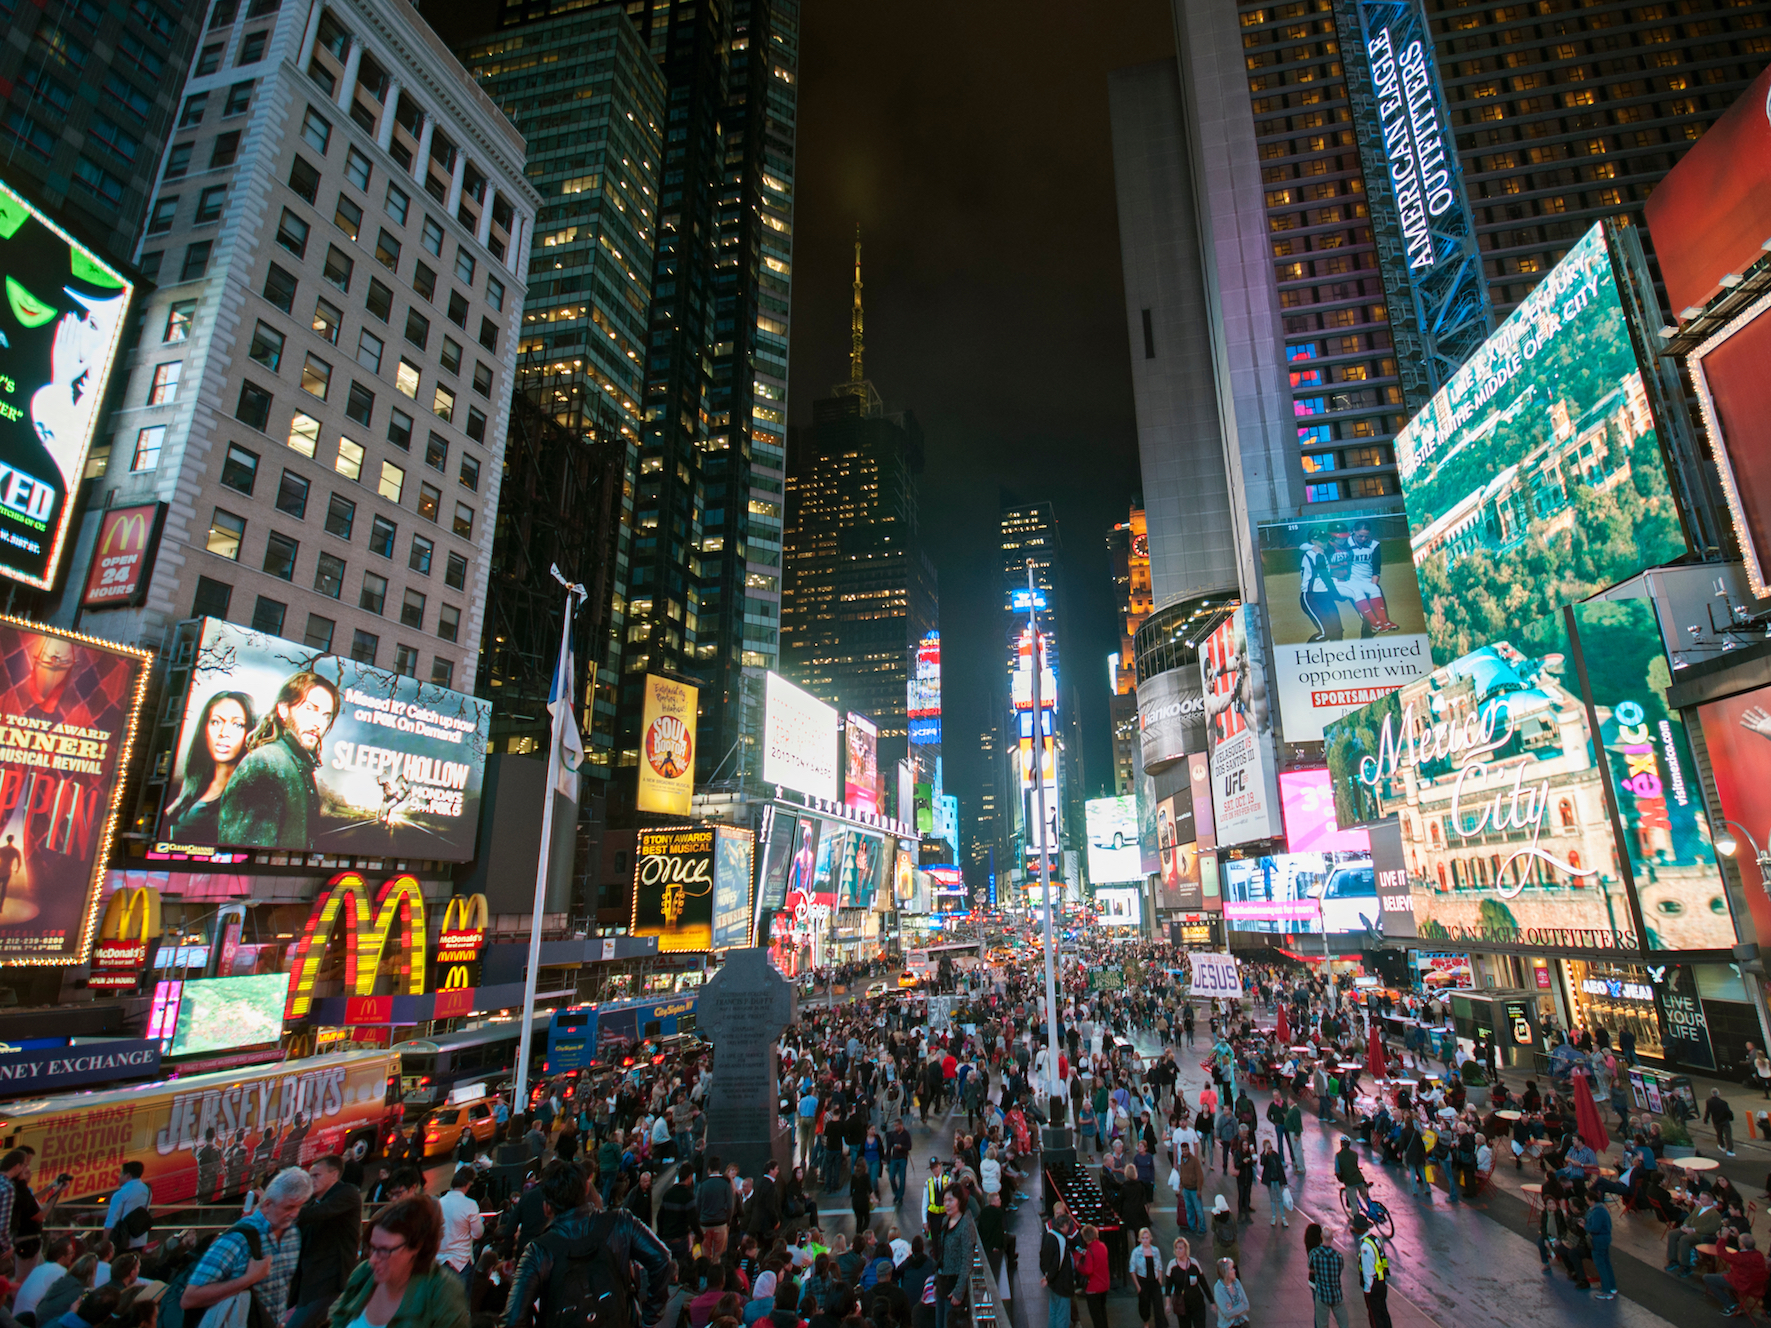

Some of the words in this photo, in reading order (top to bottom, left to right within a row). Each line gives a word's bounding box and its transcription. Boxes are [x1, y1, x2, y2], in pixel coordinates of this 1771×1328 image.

[1368, 27, 1402, 121] EAGLE
[1399, 40, 1453, 216] OUTFITTERS
[1383, 115, 1434, 270] AMERICAN
[1519, 250, 1585, 330] CENTURY
[1436, 426, 1451, 446] IN
[1446, 401, 1473, 434] THE
[1473, 353, 1523, 411] MIDDLE
[1523, 331, 1546, 360] OF
[1548, 319, 1563, 340] A
[1563, 274, 1599, 321] CITY
[101, 554, 138, 568] OPEN
[100, 566, 131, 585] 24
[88, 583, 136, 599] HOURS
[1295, 645, 1356, 667] Helped
[1360, 640, 1421, 663] injured
[1299, 666, 1380, 687] opponent
[1384, 660, 1423, 676] win.
[1016, 700, 1054, 709] TOSBA
[1314, 686, 1399, 706] SPORTSMANS
[344, 687, 391, 713] Missed
[390, 699, 407, 715] it?
[405, 704, 439, 724] Catch
[439, 714, 454, 729] up
[453, 718, 476, 733] now
[6, 713, 53, 731] TONY
[354, 709, 373, 723] on
[372, 710, 397, 729] FOX
[397, 716, 415, 733] On
[414, 721, 463, 744] Demand!
[653, 717, 687, 745] SOUL
[654, 739, 687, 757] DOCTOR
[1360, 698, 1515, 786] Mexico
[52, 755, 102, 775] REVIVAL
[331, 740, 405, 779] SLEEPY
[403, 753, 470, 790] HOLLOW
[1225, 753, 1248, 772] SANTOS
[1659, 720, 1688, 806] visitmexico.com
[1225, 768, 1245, 797] UFC
[411, 785, 464, 804] MONDAYS
[1247, 791, 1255, 804] 19
[429, 800, 452, 816] FOX
[451, 803, 463, 817] 5
[803, 792, 843, 816] 1540
[845, 804, 909, 836] BROADWAY
[643, 835, 650, 845] 8
[649, 834, 674, 844] TONY
[673, 832, 712, 844] AWARDS
[1451, 761, 1598, 899] City
[642, 845, 667, 855] BEST
[669, 843, 712, 854] MUSICAL
[1379, 871, 1397, 888] LIVE
[1396, 869, 1405, 886] IT
[439, 934, 483, 944] McDonald's
[1417, 925, 1477, 941] AMERICAN
[1481, 926, 1524, 944] EAGLE
[1527, 928, 1638, 949] OUTFITTERS
[93, 946, 146, 959] McDonald's
[115, 977, 136, 985] HOURS
[1194, 964, 1238, 990] JESUS
[1583, 980, 1608, 995] AEO
[654, 1003, 686, 1019] CitySights
[1662, 994, 1695, 1012] LIVE
[1664, 1009, 1708, 1028] YOUR
[1668, 1024, 1700, 1042] LIFE
[47, 1050, 154, 1075] EXCHANGE
[87, 1104, 137, 1129] MOST
[157, 1080, 276, 1155] JERSEY
[279, 1067, 346, 1127] BOYS
[41, 1122, 133, 1158] EXCITING
[37, 1145, 129, 1182] MUSICAL
